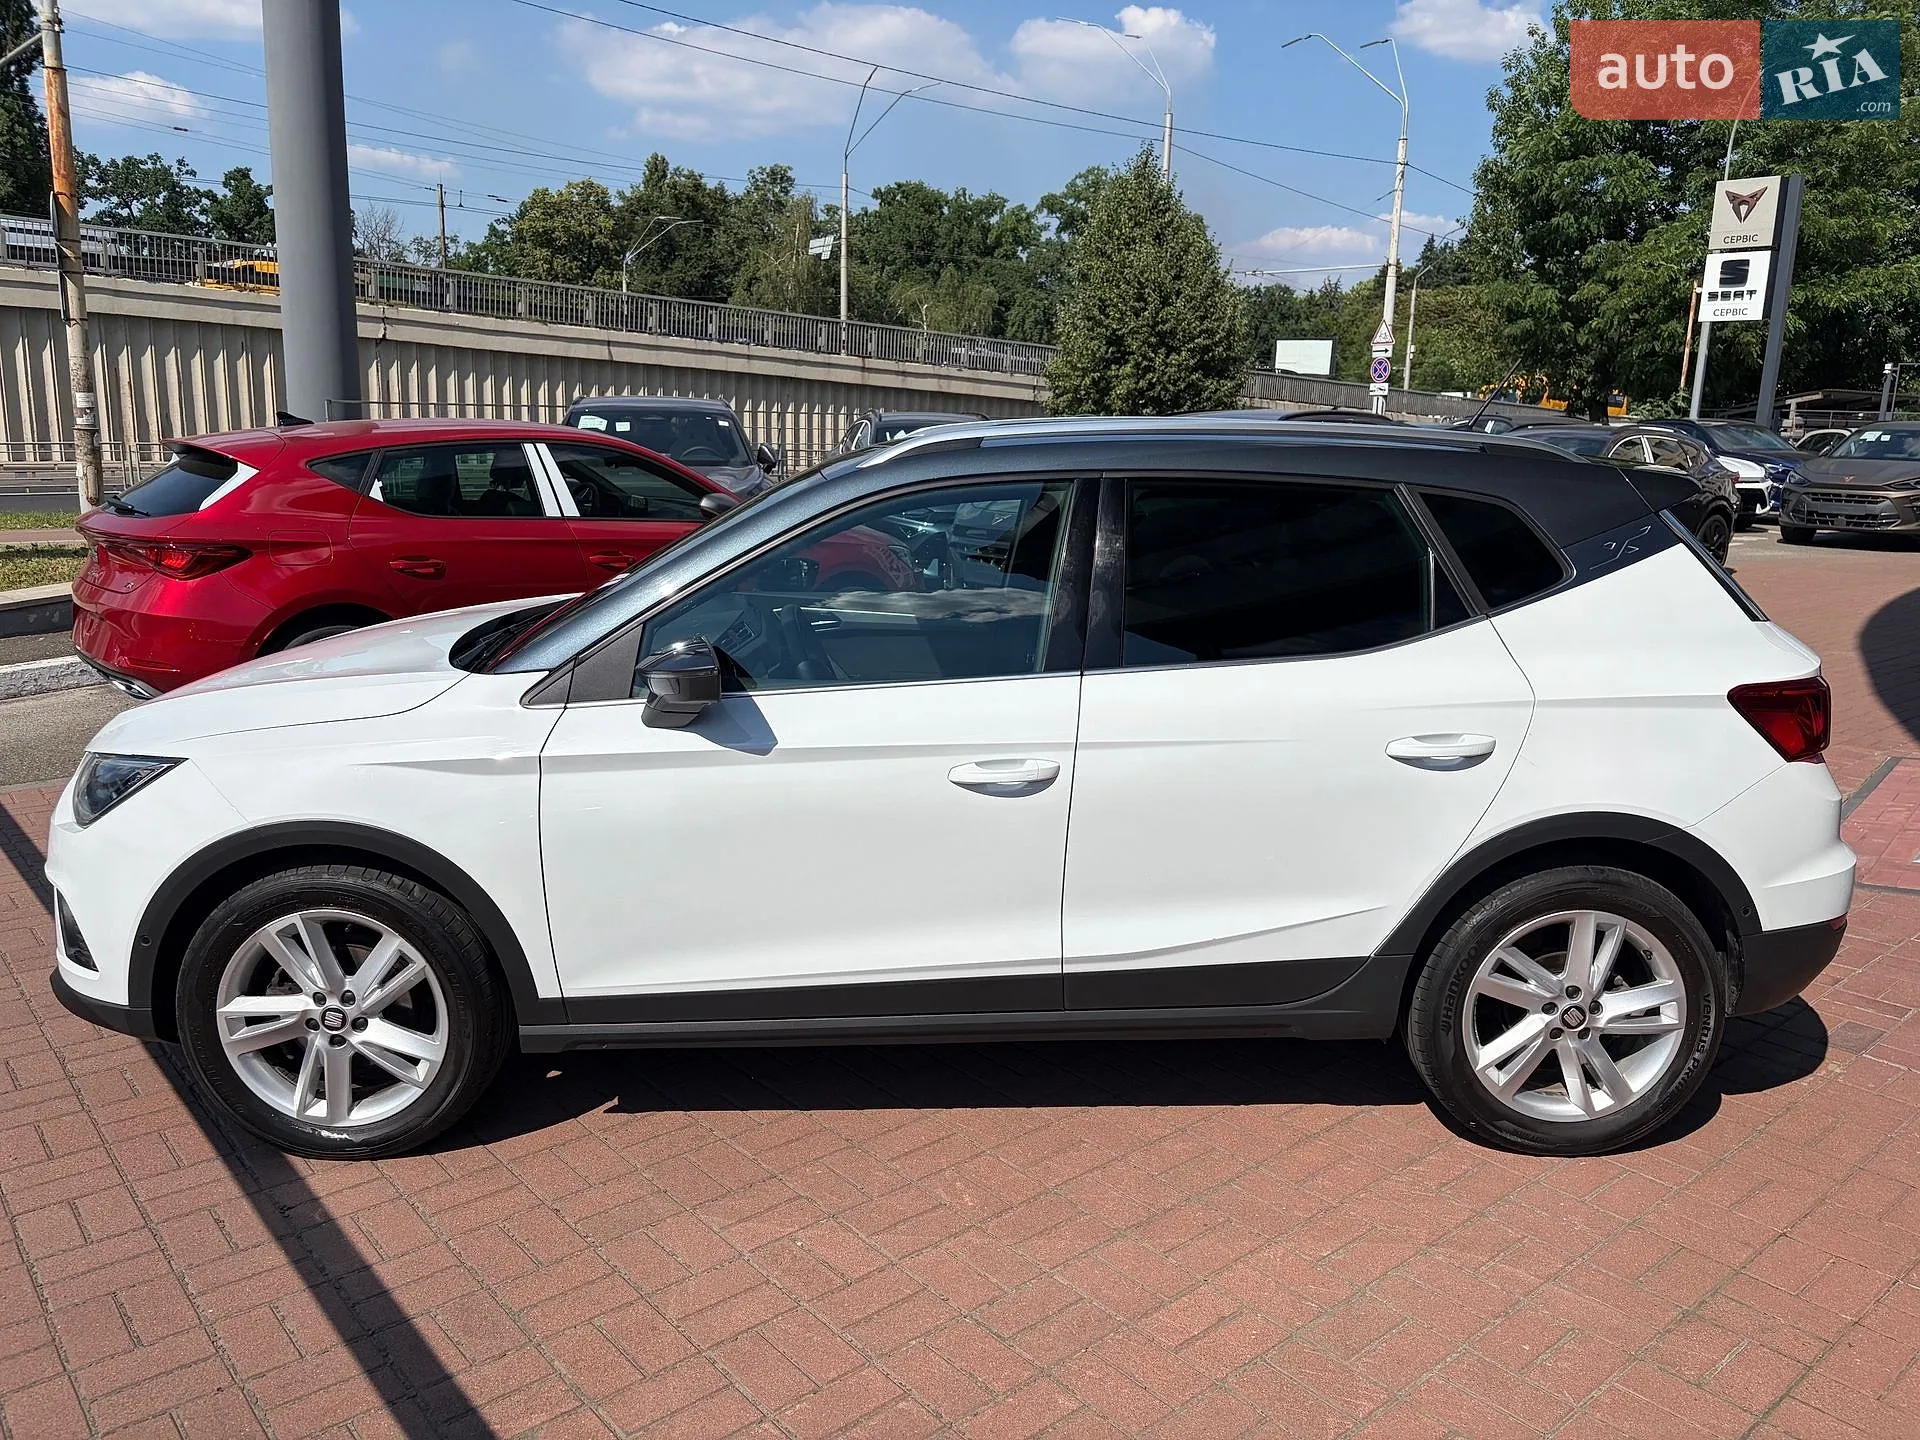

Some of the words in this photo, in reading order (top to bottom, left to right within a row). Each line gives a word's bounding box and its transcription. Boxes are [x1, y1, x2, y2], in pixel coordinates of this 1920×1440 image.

[1723, 234, 1759, 244] СЕРВІС
[1707, 289, 1757, 302] SEAT
[1713, 308, 1748, 317] СЕРВІС
